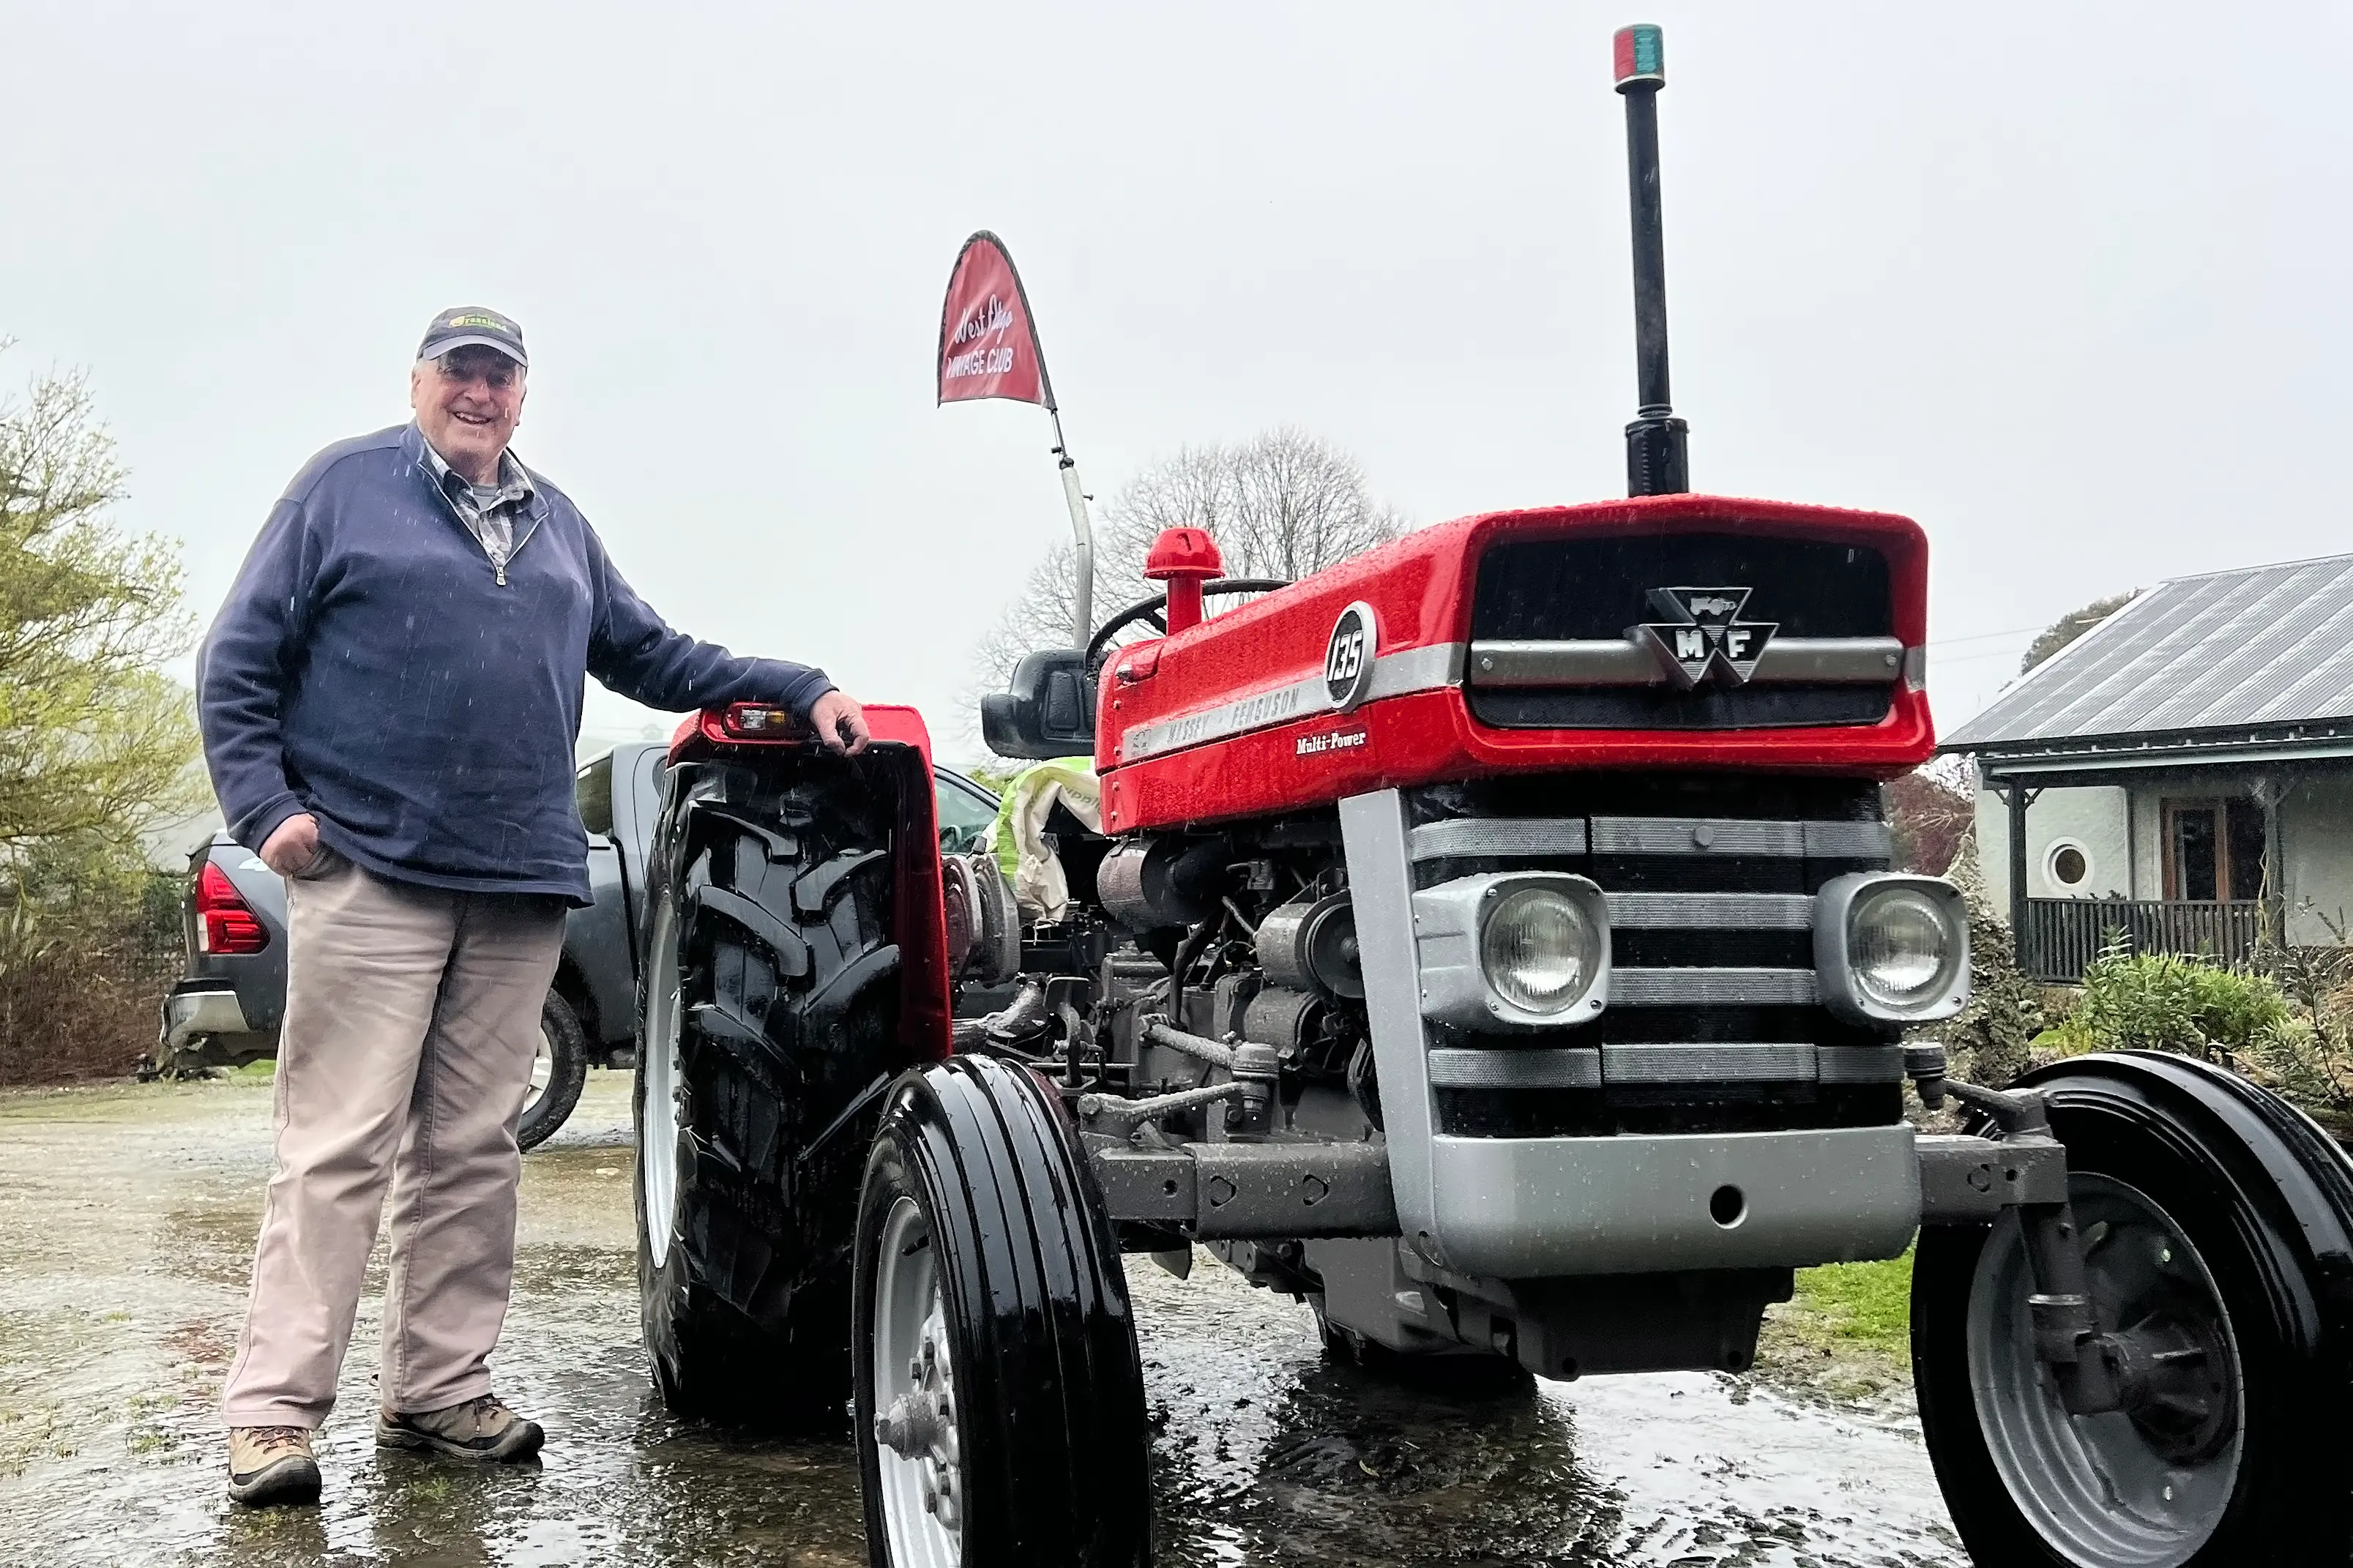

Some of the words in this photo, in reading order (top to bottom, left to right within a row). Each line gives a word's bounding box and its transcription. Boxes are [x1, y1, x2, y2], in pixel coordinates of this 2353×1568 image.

[955, 305, 985, 344] West
[987, 347, 1013, 374] CLUB
[1327, 630, 1363, 682] 135
[1167, 714, 1210, 745] MASSEY
[1231, 687, 1300, 729] FERGUSON
[1296, 731, 1366, 755] Multi-Power
